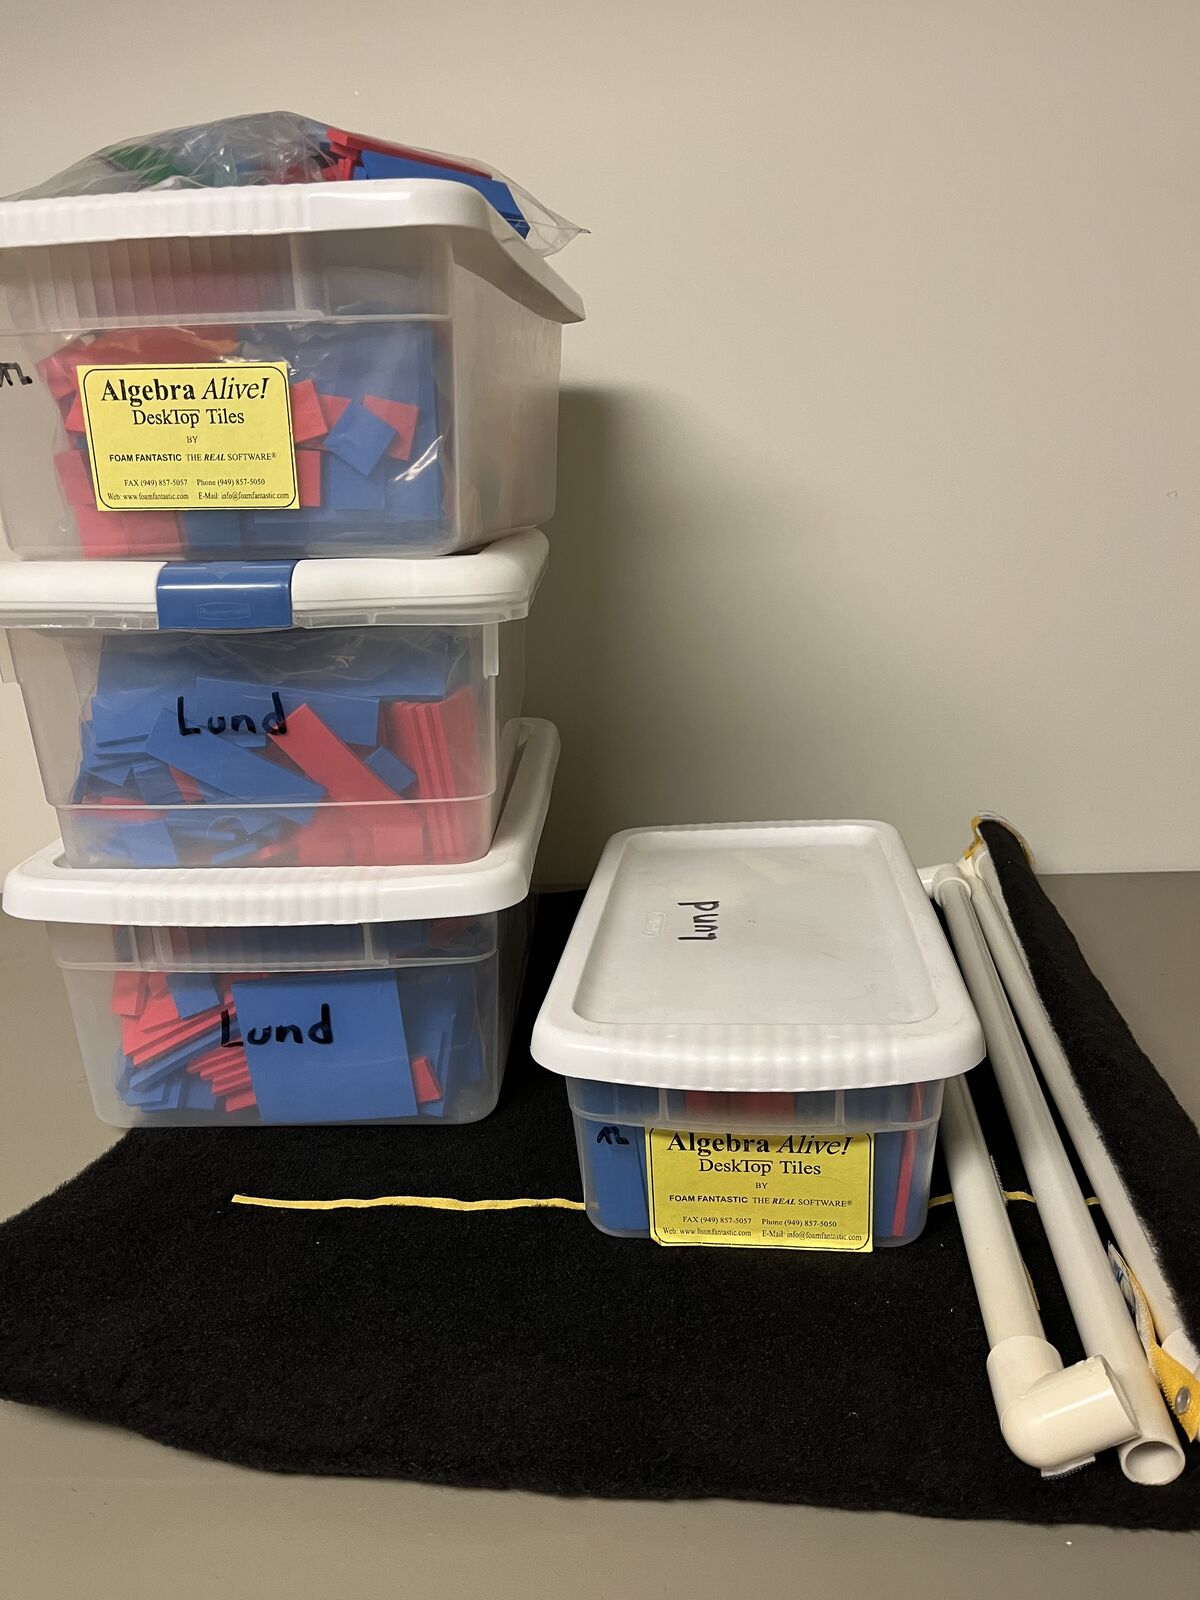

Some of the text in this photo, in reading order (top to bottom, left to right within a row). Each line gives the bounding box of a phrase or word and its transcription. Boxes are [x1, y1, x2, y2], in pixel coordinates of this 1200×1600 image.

[101, 377, 269, 407] Algebra Alive!
[132, 409, 244, 428] DeskTop Tiles
[141, 479, 157, 487] (949)
[221, 492, 289, 501] info@foamfantastic.com
[178, 692, 287, 736] Lund
[678, 901, 719, 940] Lund
[221, 1003, 333, 1047] Lund
[667, 1132, 853, 1156] Algebra Alive!
[699, 1159, 821, 1176] DeskTop Tiles
[787, 1231, 862, 1240] info@foamfantastic.com
